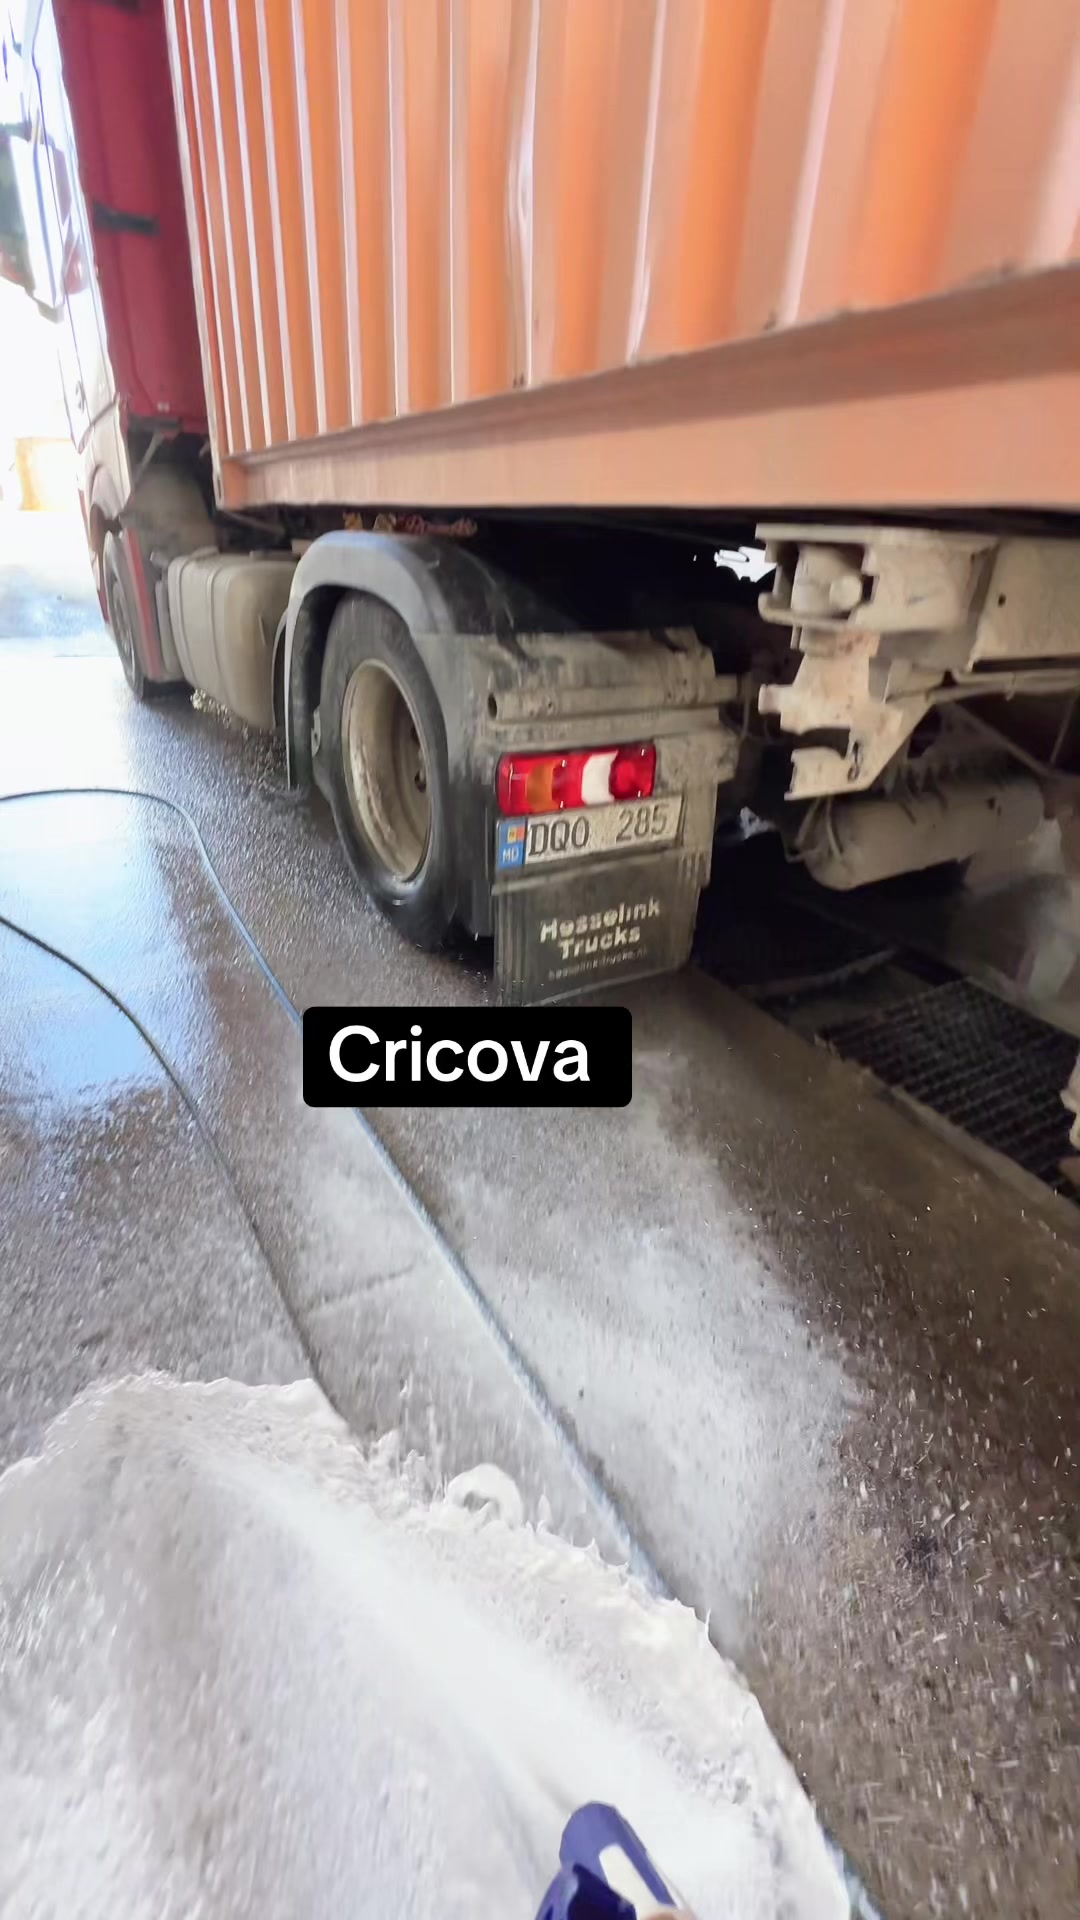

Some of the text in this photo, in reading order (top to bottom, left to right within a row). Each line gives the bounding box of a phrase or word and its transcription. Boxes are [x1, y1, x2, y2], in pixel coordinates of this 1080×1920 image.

[528, 803, 668, 856] DQO 285
[502, 847, 519, 863] MD
[558, 926, 640, 960] Trucks
